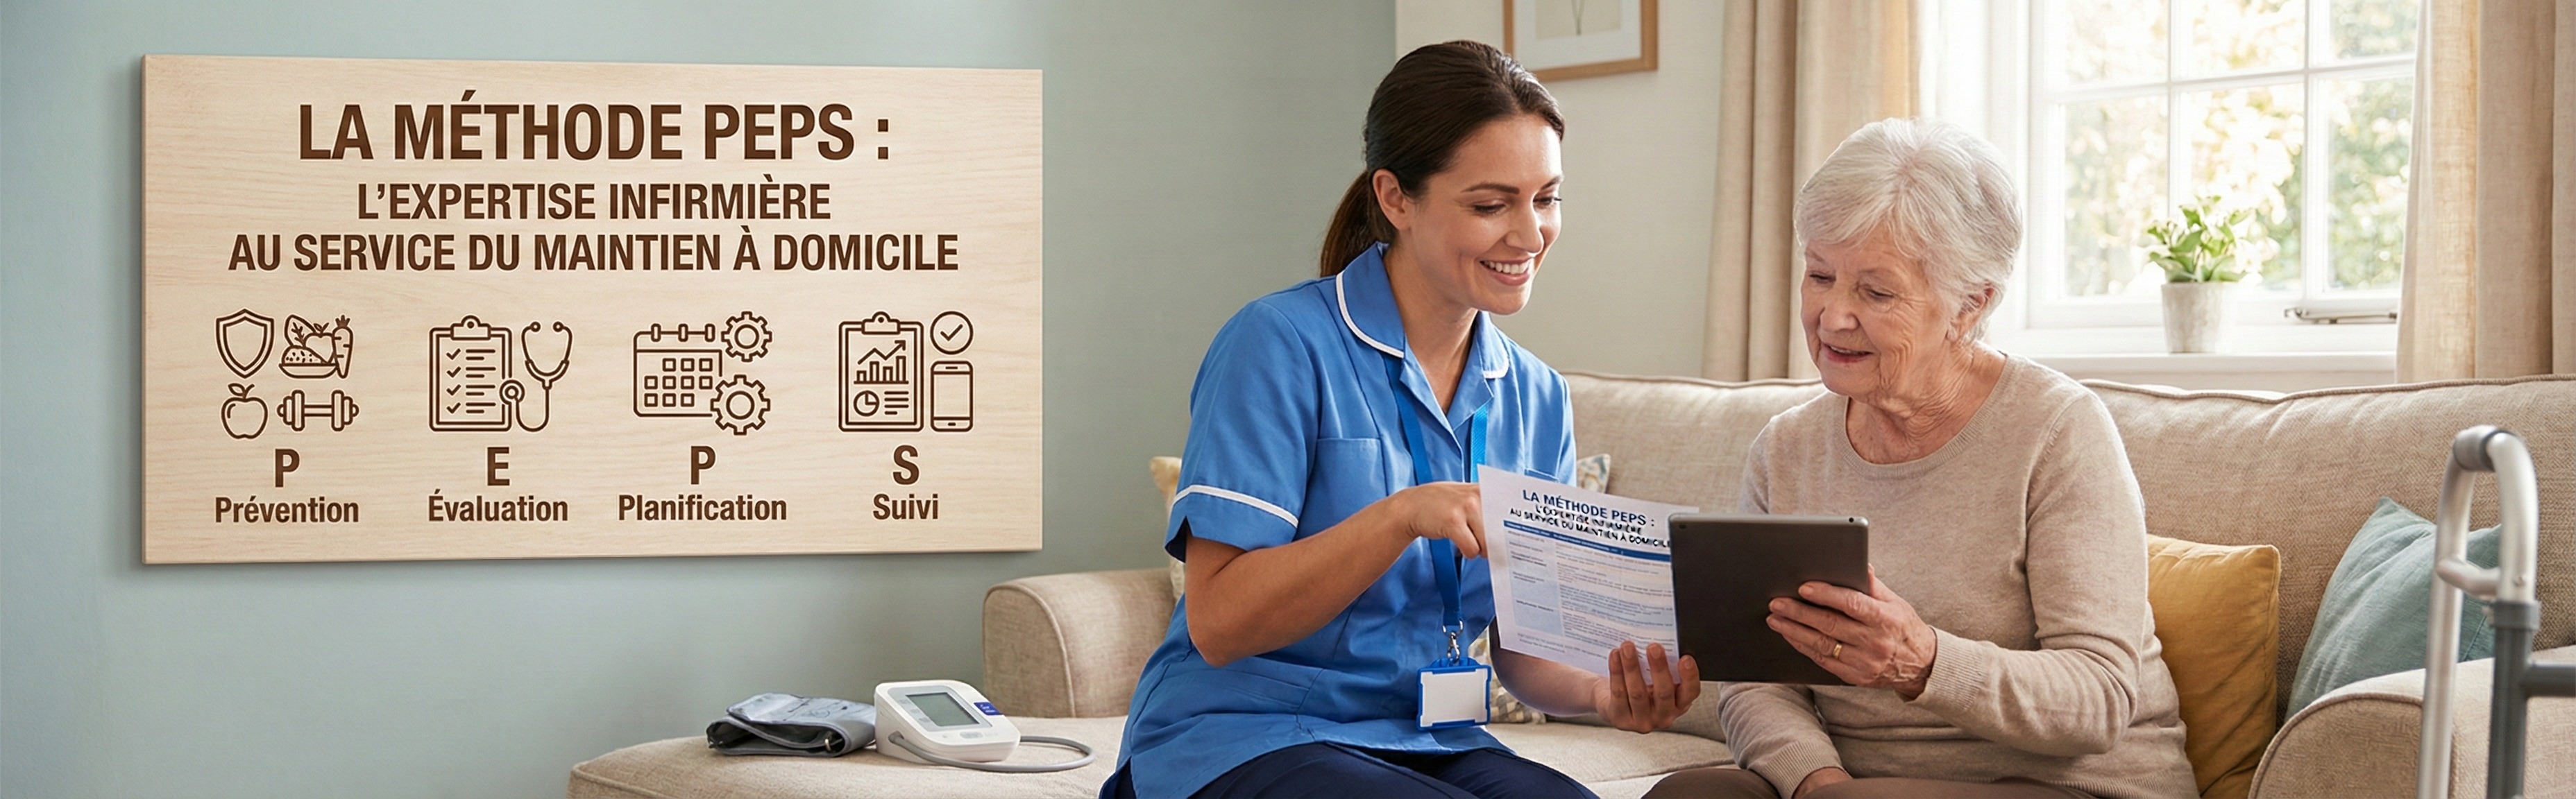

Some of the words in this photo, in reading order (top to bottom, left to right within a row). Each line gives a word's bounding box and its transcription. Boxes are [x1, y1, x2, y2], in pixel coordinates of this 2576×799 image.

[300, 104, 374, 160] LA
[394, 89, 683, 161] MÉTHODE
[704, 103, 854, 161] PEPS
[877, 119, 889, 160] :
[358, 182, 596, 220] L’EXPERTISE
[609, 173, 831, 219] INFIRMIÈRE
[228, 234, 280, 271] AU
[294, 234, 455, 271] SERVICE
[469, 234, 520, 271] DU
[534, 234, 720, 270] MAINTIEN
[733, 225, 761, 270] À
[774, 234, 958, 271] DOMICILE
[275, 448, 300, 488] P
[487, 446, 510, 486] E
[690, 445, 716, 485] P
[892, 445, 920, 486] S
[215, 495, 359, 524] Prévention
[428, 488, 568, 522] Évaluation
[619, 494, 787, 521] Planification
[872, 493, 938, 520] Suivi
[1523, 489, 1540, 503] LA
[1543, 494, 1608, 519] MÉTHODE
[1611, 509, 1647, 526] PEPS
